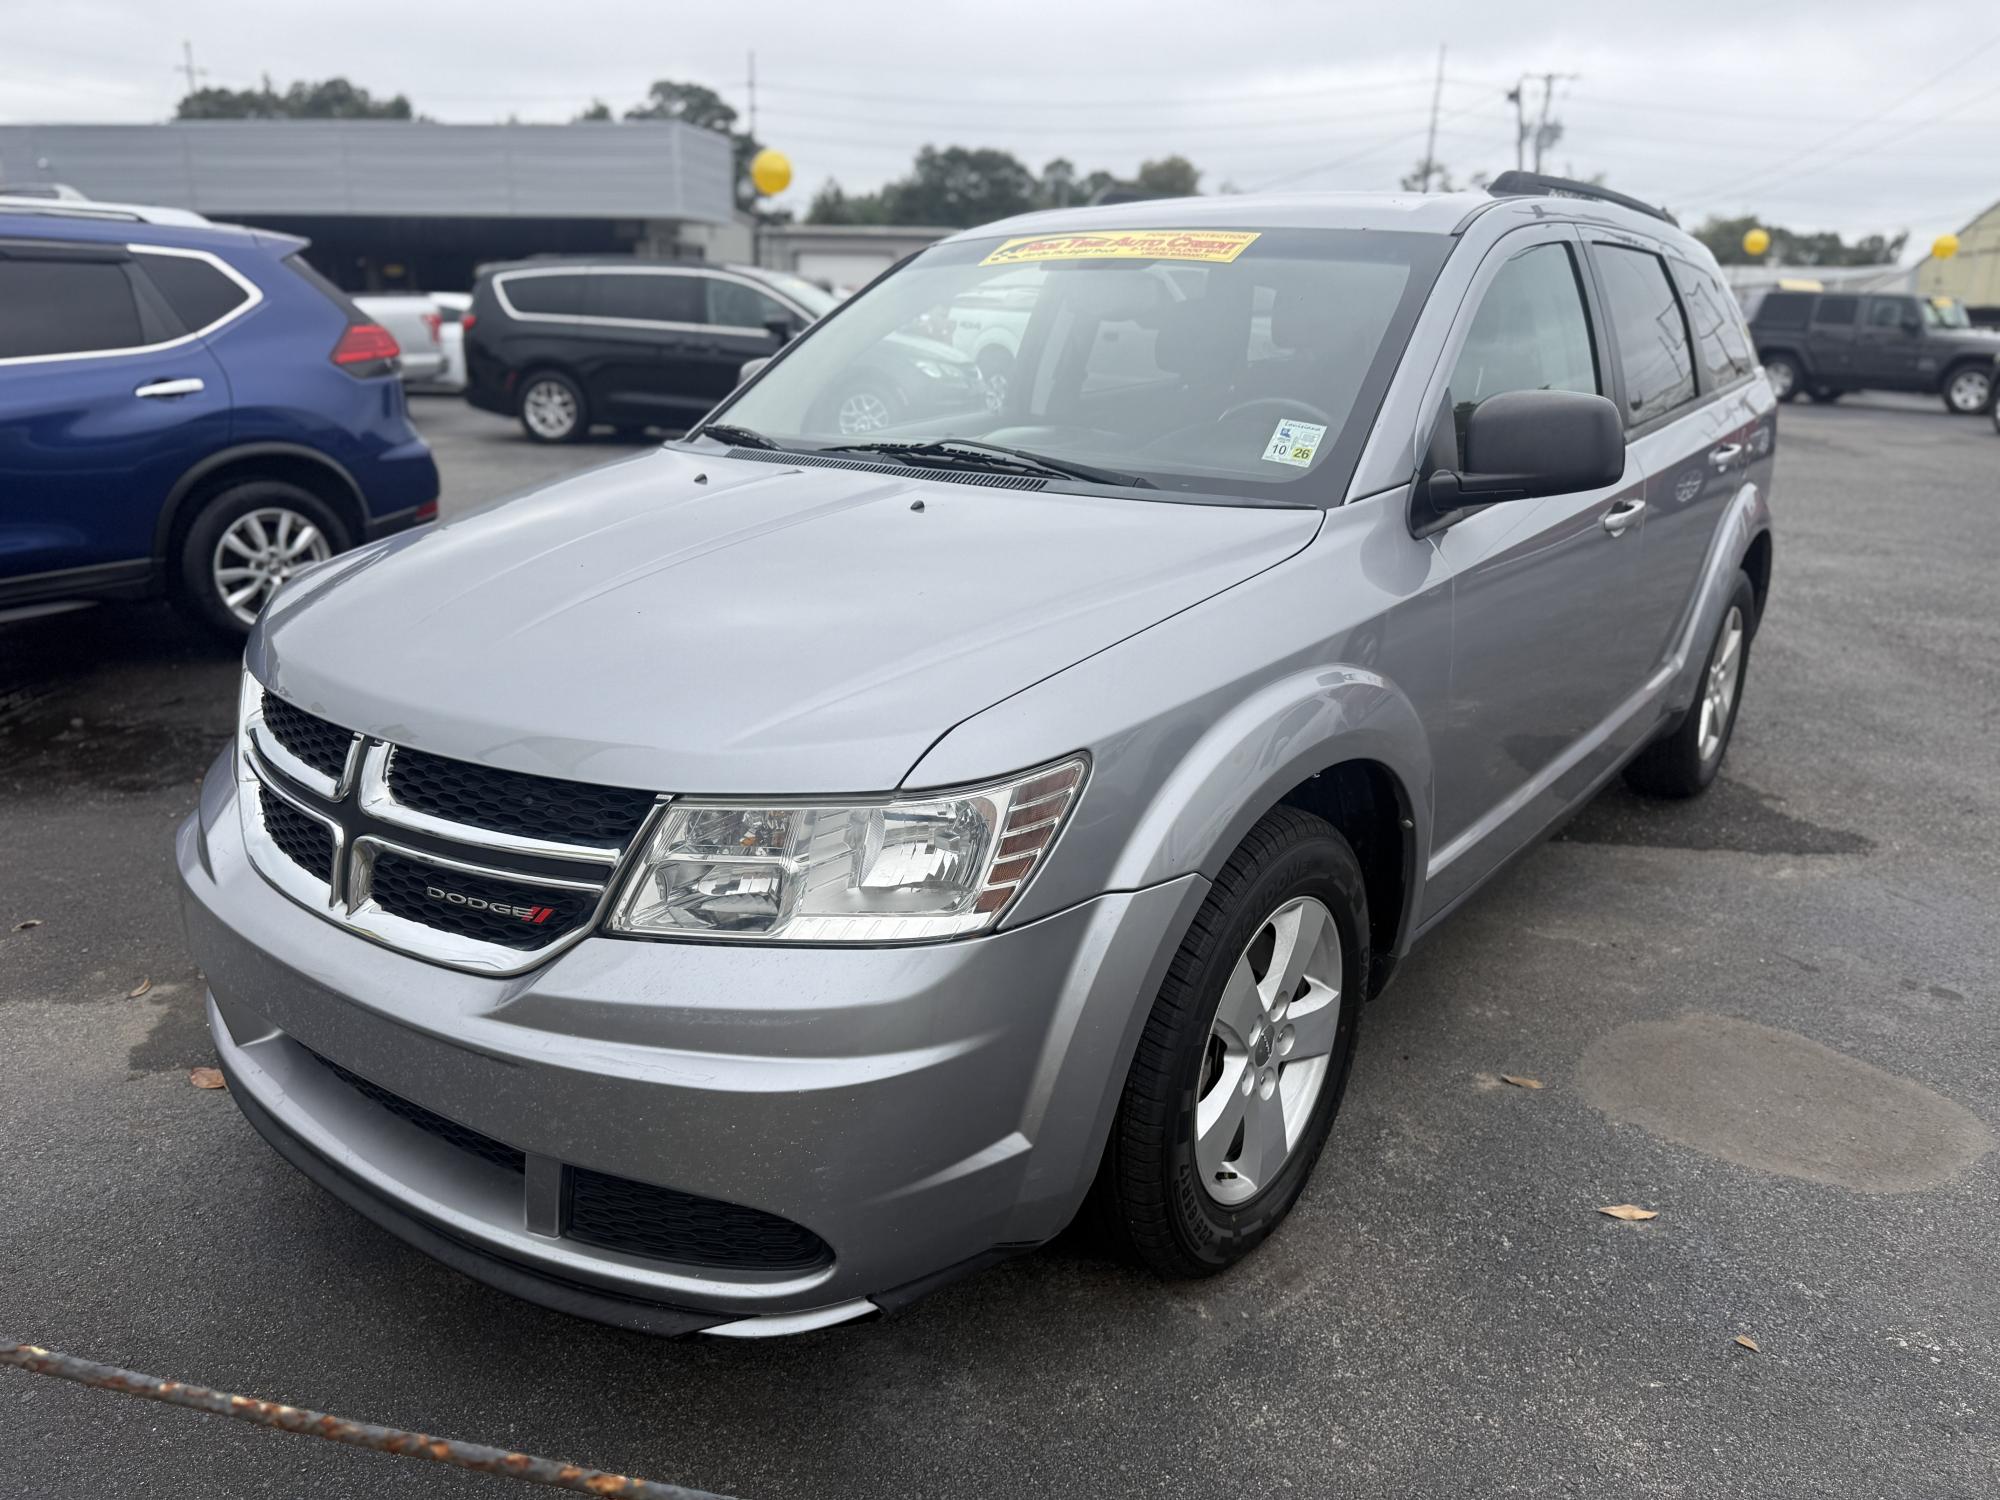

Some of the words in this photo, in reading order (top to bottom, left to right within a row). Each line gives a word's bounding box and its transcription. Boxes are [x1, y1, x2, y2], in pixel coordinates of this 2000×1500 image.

[1107, 236, 1165, 248] AUTO
[1167, 235, 1244, 250] CREDIT
[1272, 444, 1287, 456] 10
[1293, 448, 1311, 460] 26
[427, 886, 534, 920] DODGE
